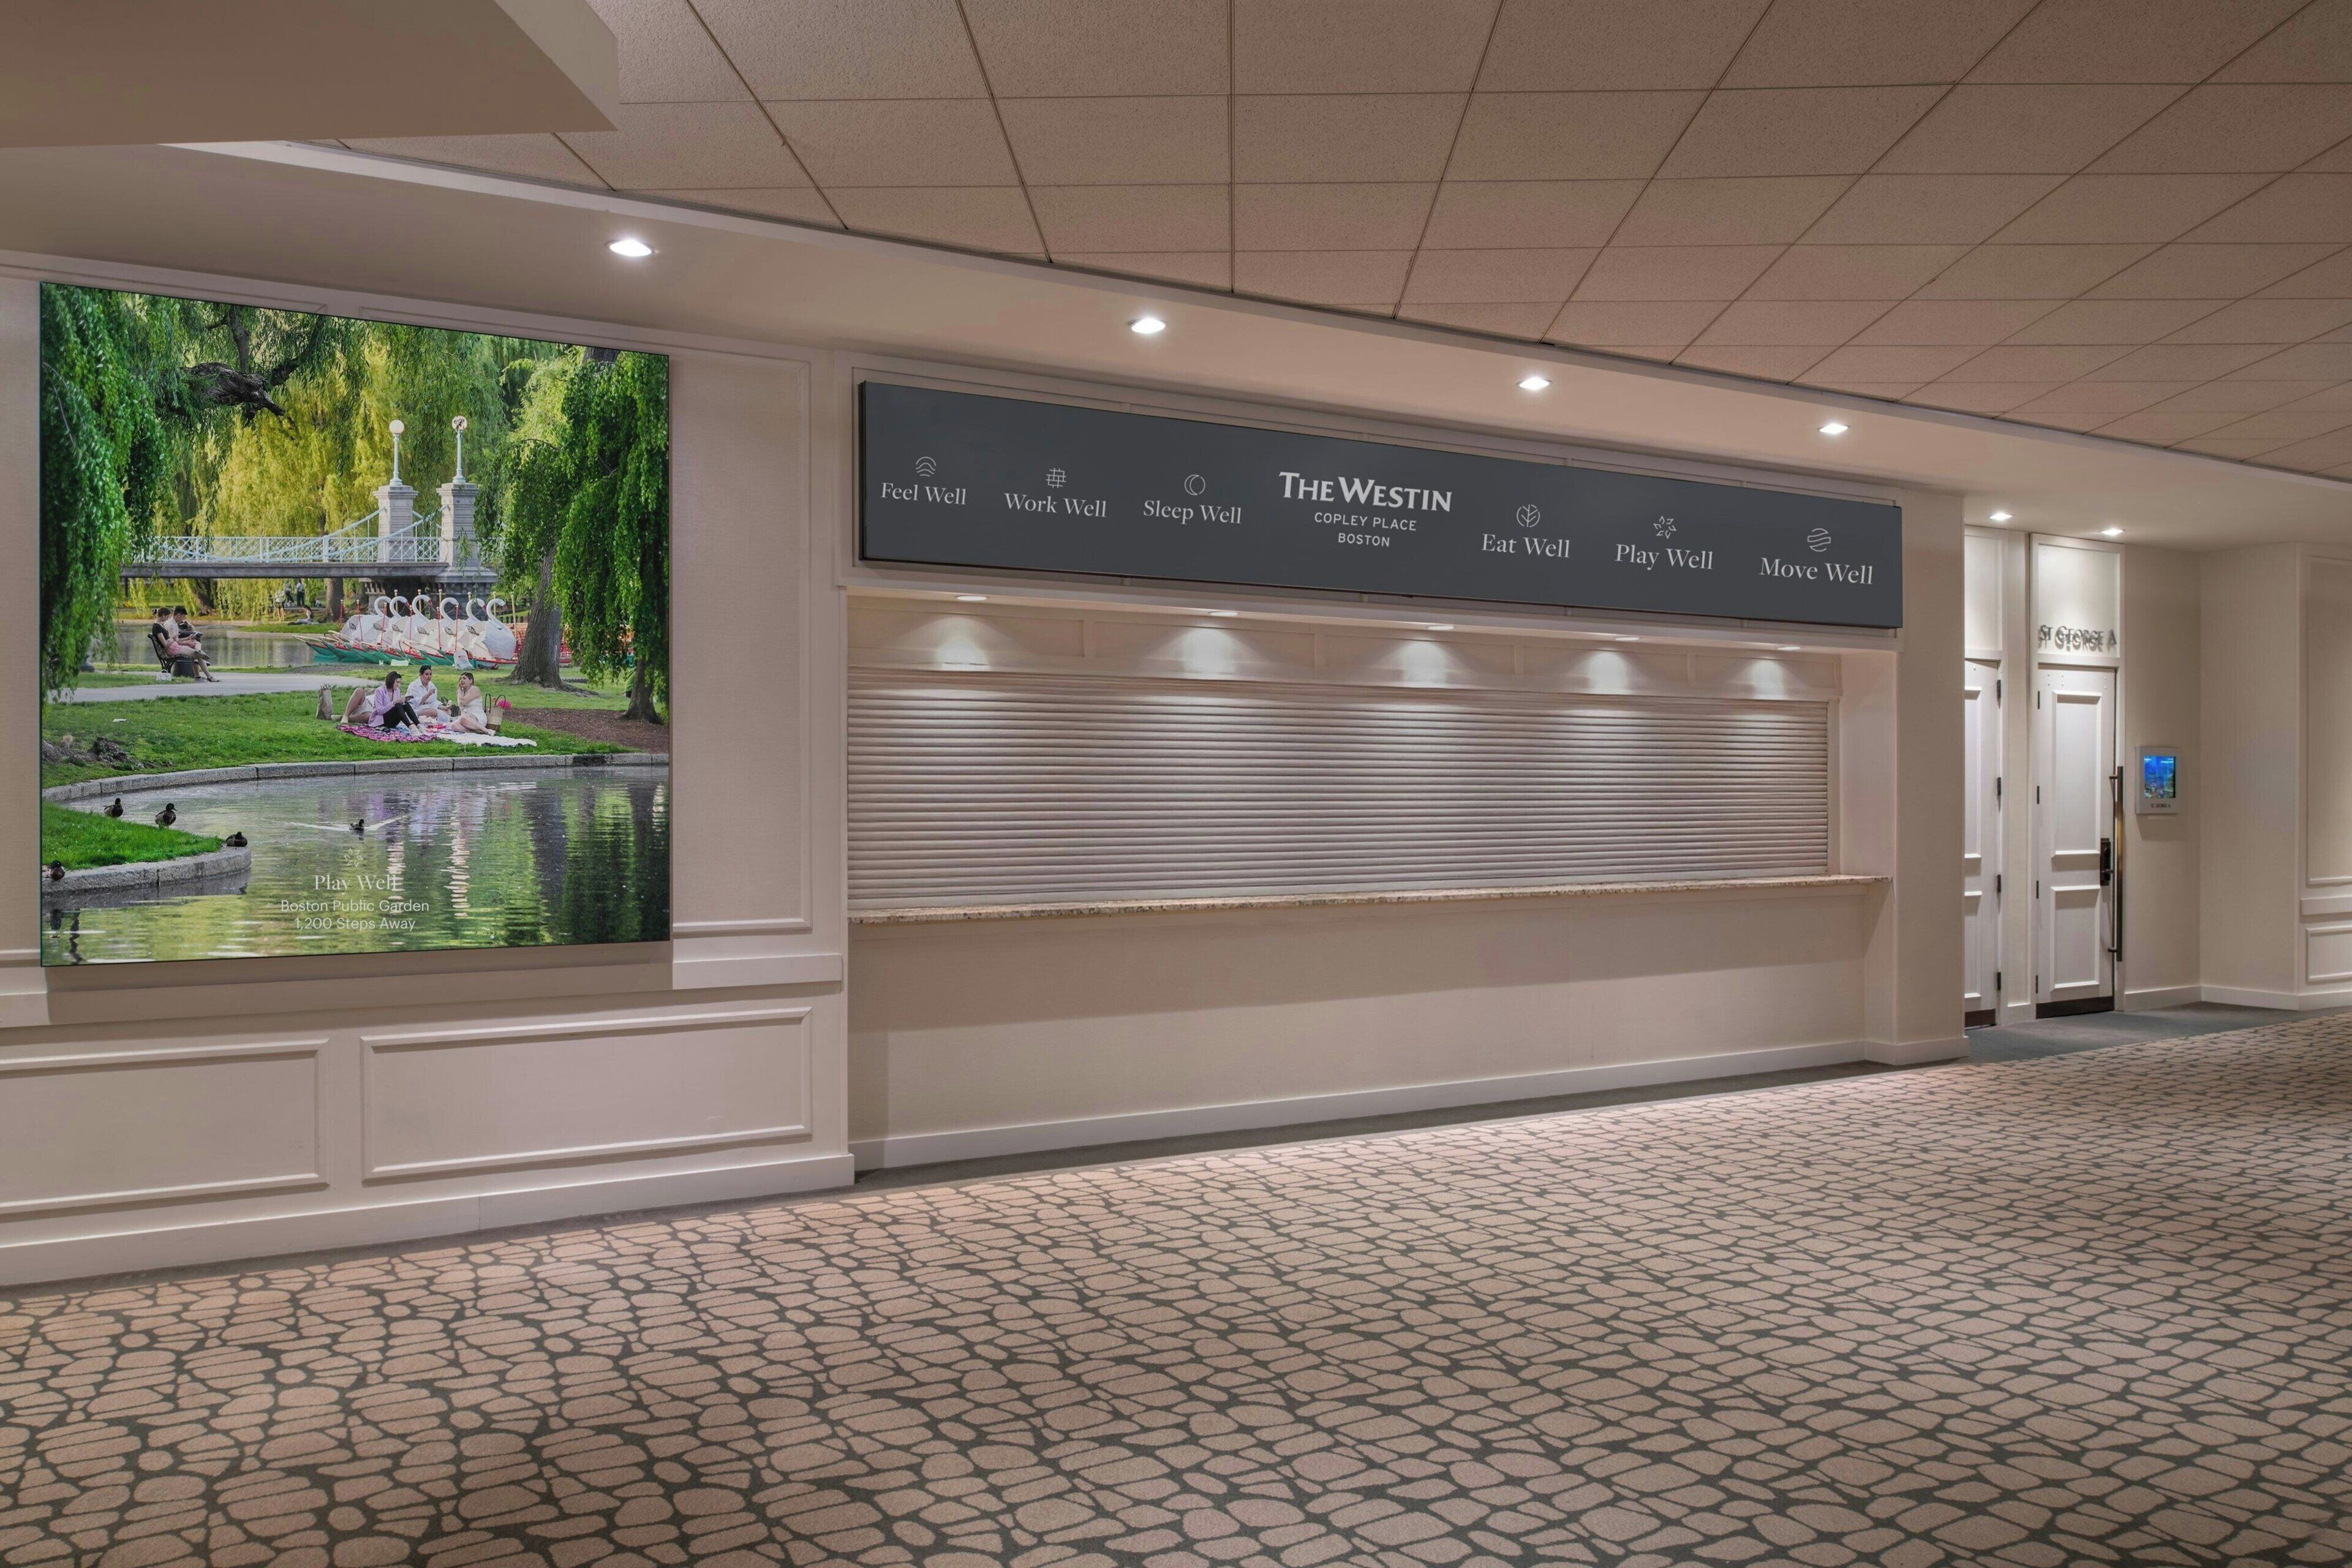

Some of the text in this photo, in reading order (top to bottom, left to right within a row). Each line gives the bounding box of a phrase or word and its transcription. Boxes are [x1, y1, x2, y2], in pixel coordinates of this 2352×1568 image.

[881, 482, 966, 505] Feel Well
[1278, 471, 1452, 512] THE WESTIN
[1005, 492, 1107, 518] Work Well
[1143, 500, 1242, 525] Sleep Well
[1314, 512, 1417, 531] COPLEY PLACE
[1338, 532, 1390, 547] BOSTON
[1482, 533, 1570, 558] Eat Well
[1615, 544, 1713, 571] Play Well
[1759, 557, 1874, 584] Move Well
[2108, 629, 2117, 645] A
[314, 875, 397, 895] Play Well
[281, 899, 429, 912] Boston Public Garden
[294, 917, 415, 932] 1,200 Steps Away
